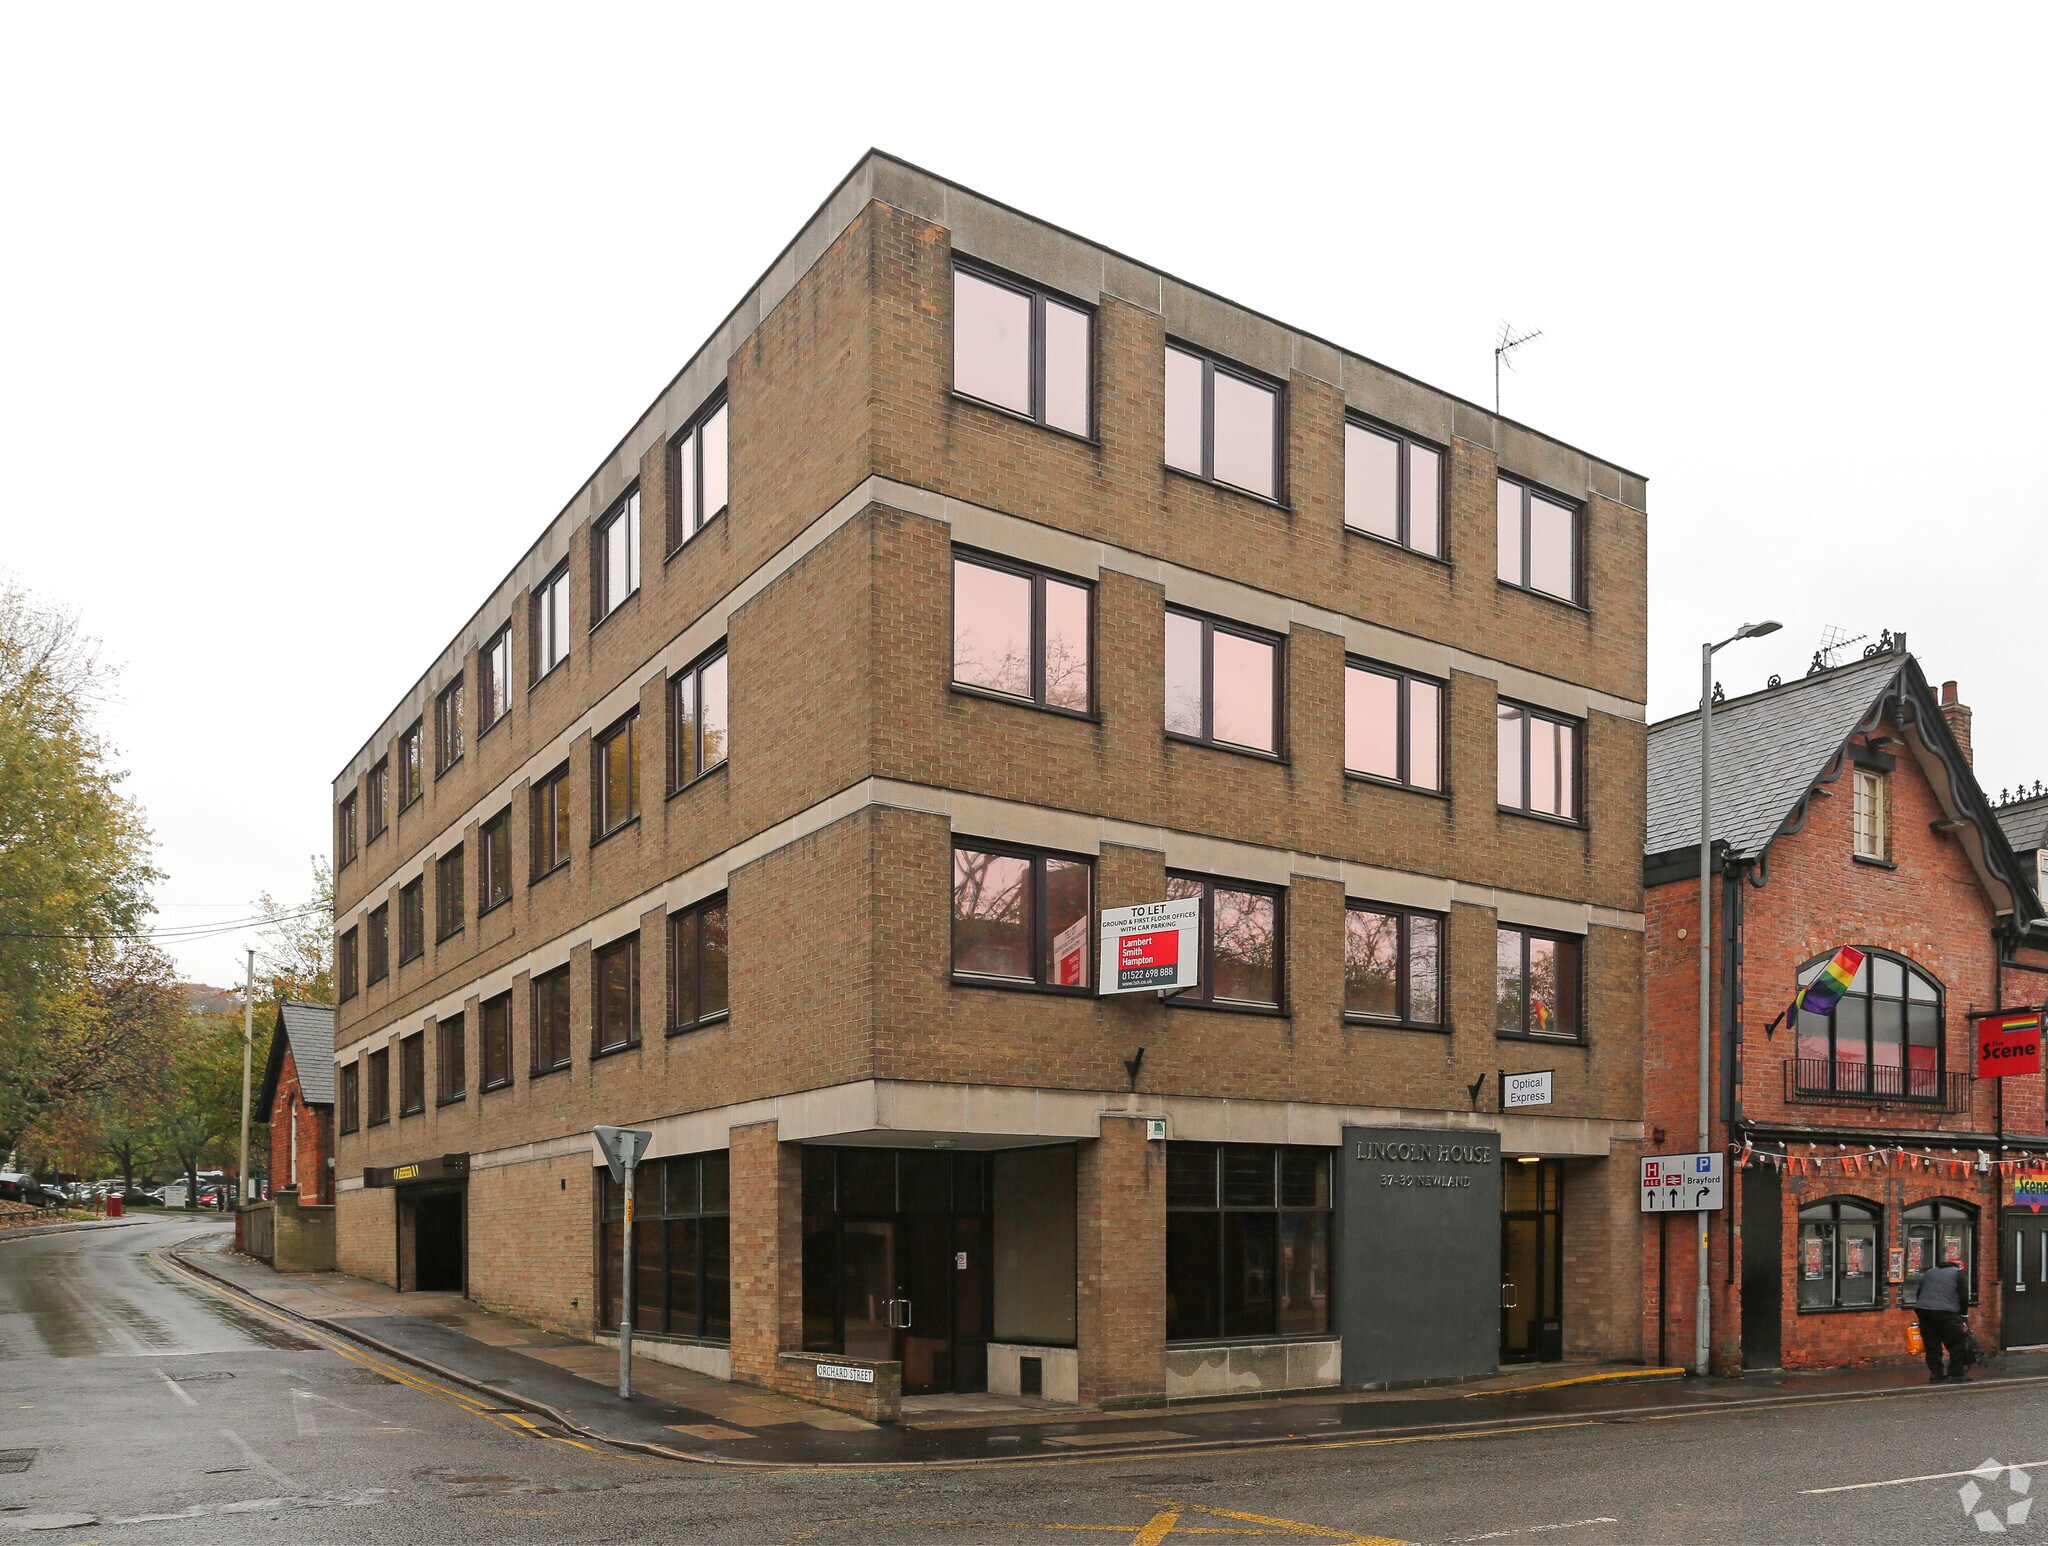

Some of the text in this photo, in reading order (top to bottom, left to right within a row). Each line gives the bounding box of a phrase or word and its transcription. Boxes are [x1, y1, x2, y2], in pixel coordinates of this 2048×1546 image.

[1131, 904, 1166, 917] TO LET
[1102, 919, 1127, 928] GROUND
[1151, 914, 1170, 922] FLOOR
[1171, 911, 1196, 920] OFFICES
[1151, 921, 1176, 930] PARKING
[1122, 937, 1152, 947] Lambert
[1122, 947, 1142, 957] Smith
[1122, 956, 1154, 966] Hampton
[1122, 967, 1173, 980] 01522 698 888
[1982, 1043, 2035, 1060] Scene
[1512, 1077, 1543, 1091] Optical
[1510, 1092, 1545, 1104] Express
[1357, 1141, 1493, 1163] LINCOLN HOUSE
[1647, 1163, 1657, 1176] H
[1700, 1158, 1708, 1171] P
[1380, 1174, 1471, 1188] 37-39 NEWLAND
[1687, 1176, 1720, 1185] Brayford
[2020, 1174, 2048, 1194] Scene
[818, 1366, 872, 1380] ORCHARD STREET
